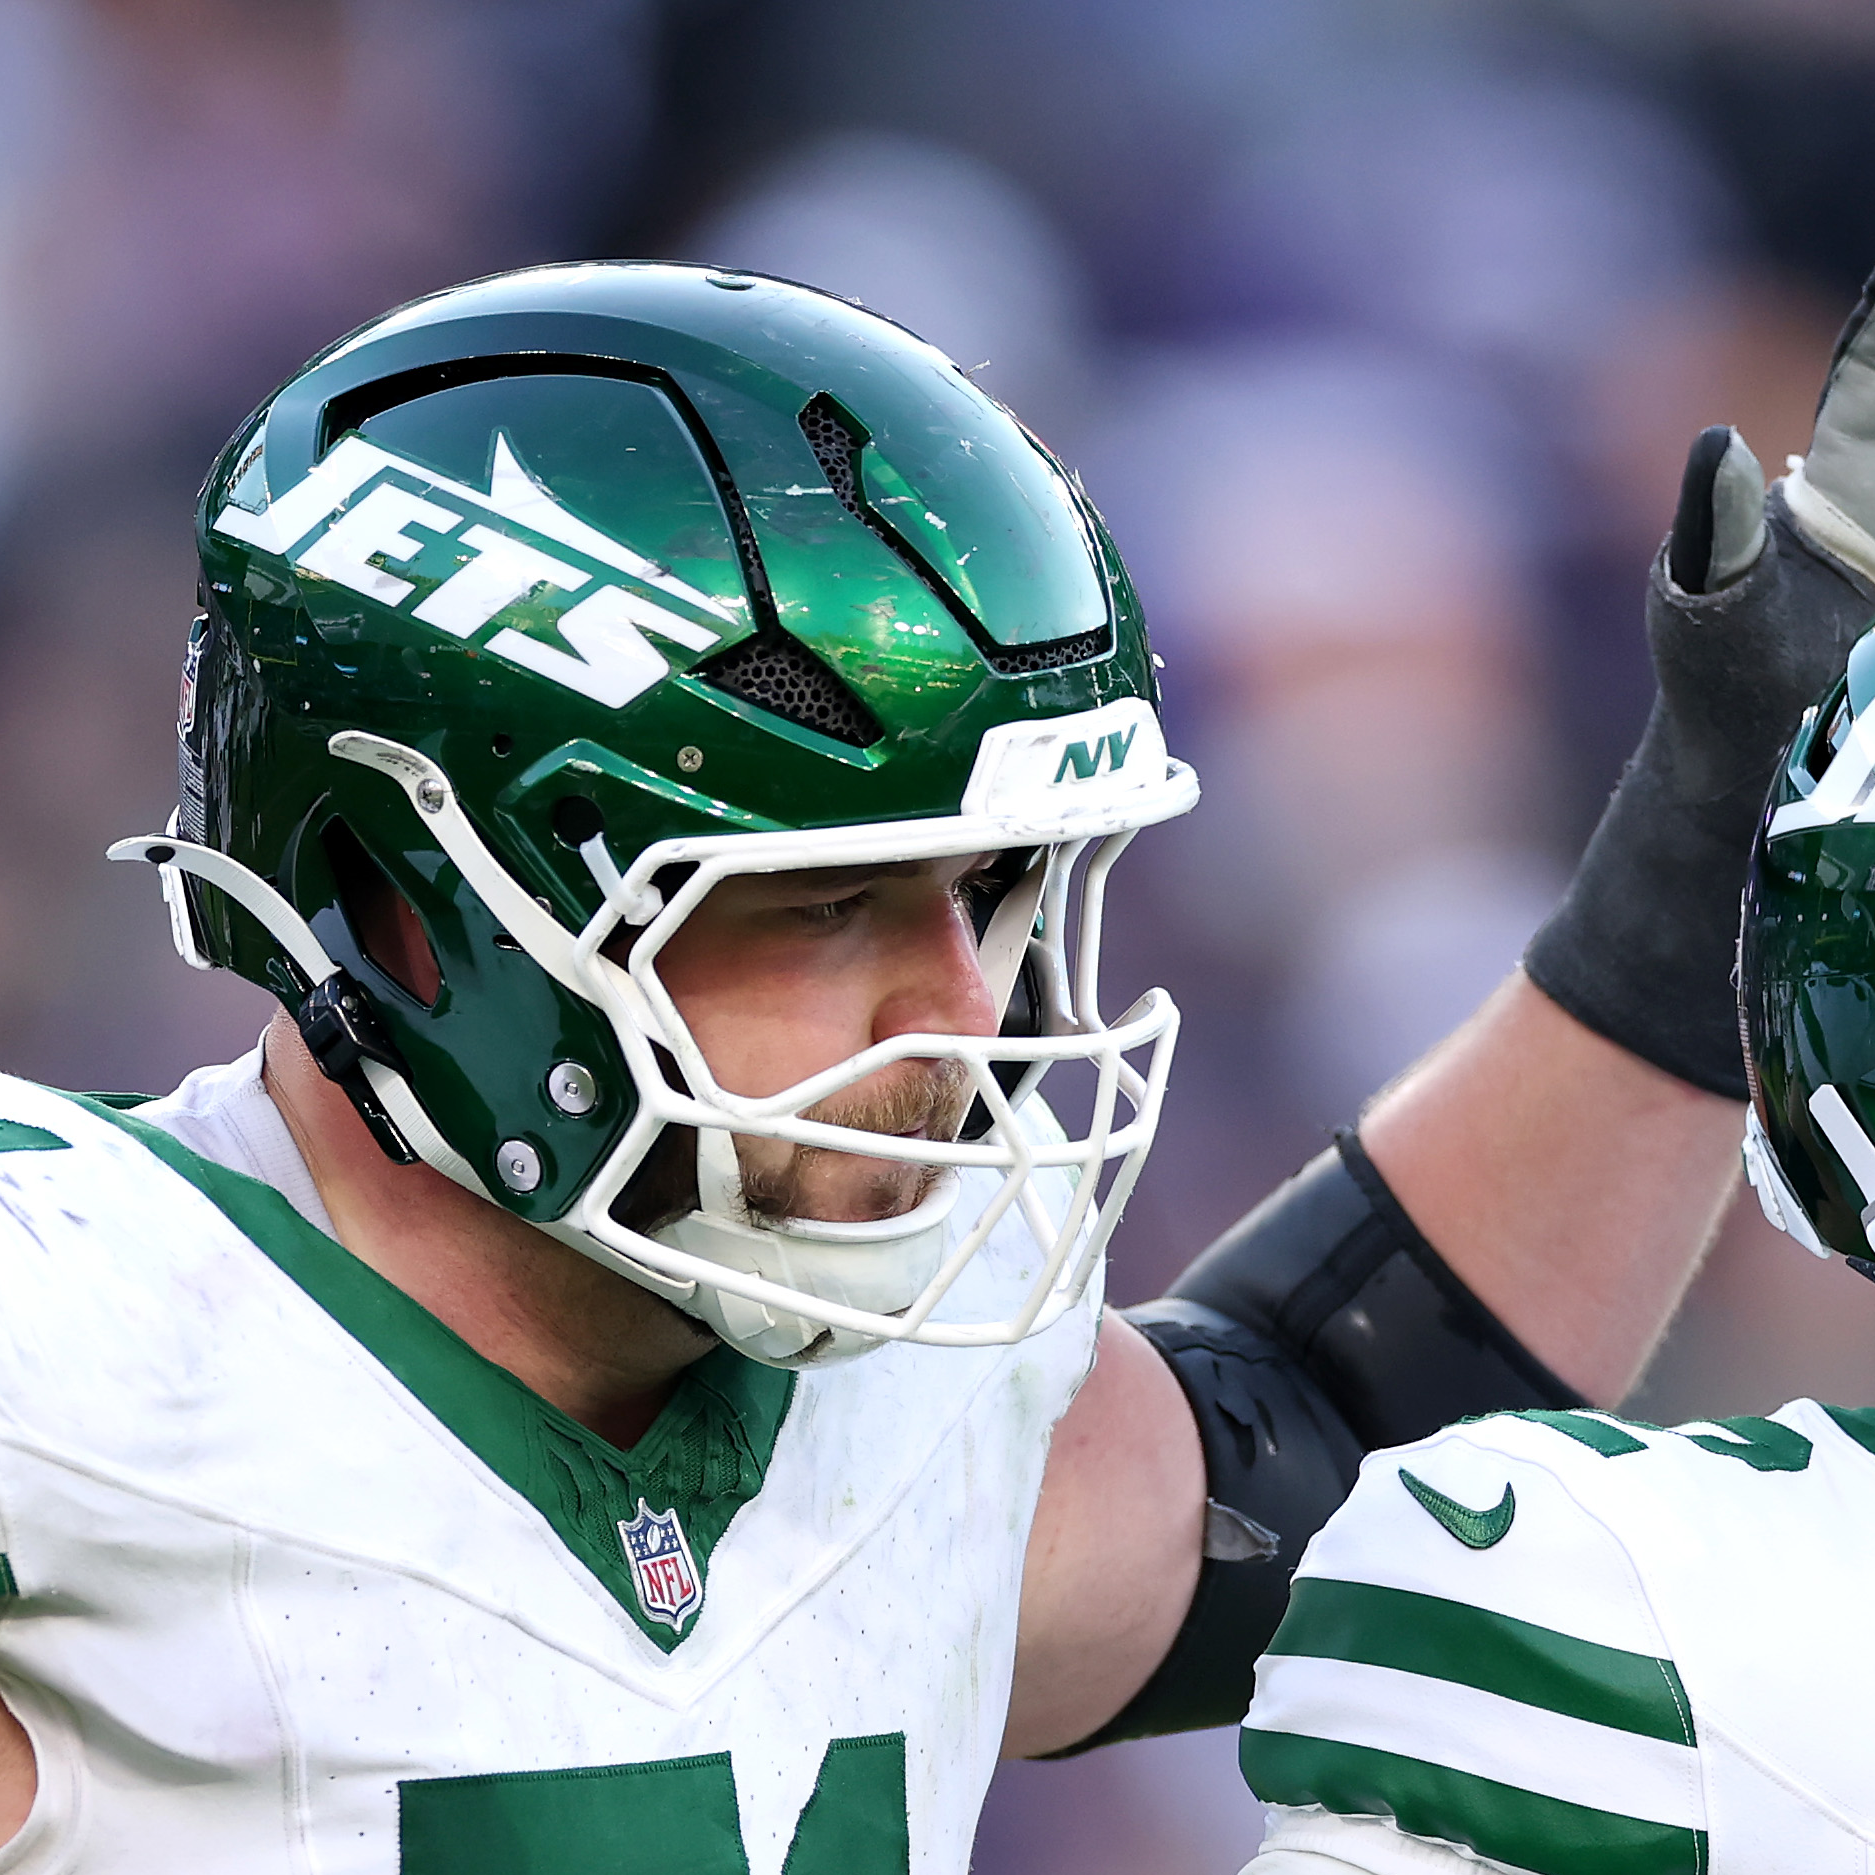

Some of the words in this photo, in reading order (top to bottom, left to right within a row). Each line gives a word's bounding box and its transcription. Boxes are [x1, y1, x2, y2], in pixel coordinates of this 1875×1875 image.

[213, 430, 739, 709] JETS
[1054, 722, 1138, 784] NY
[642, 1557, 692, 1607] NFL
